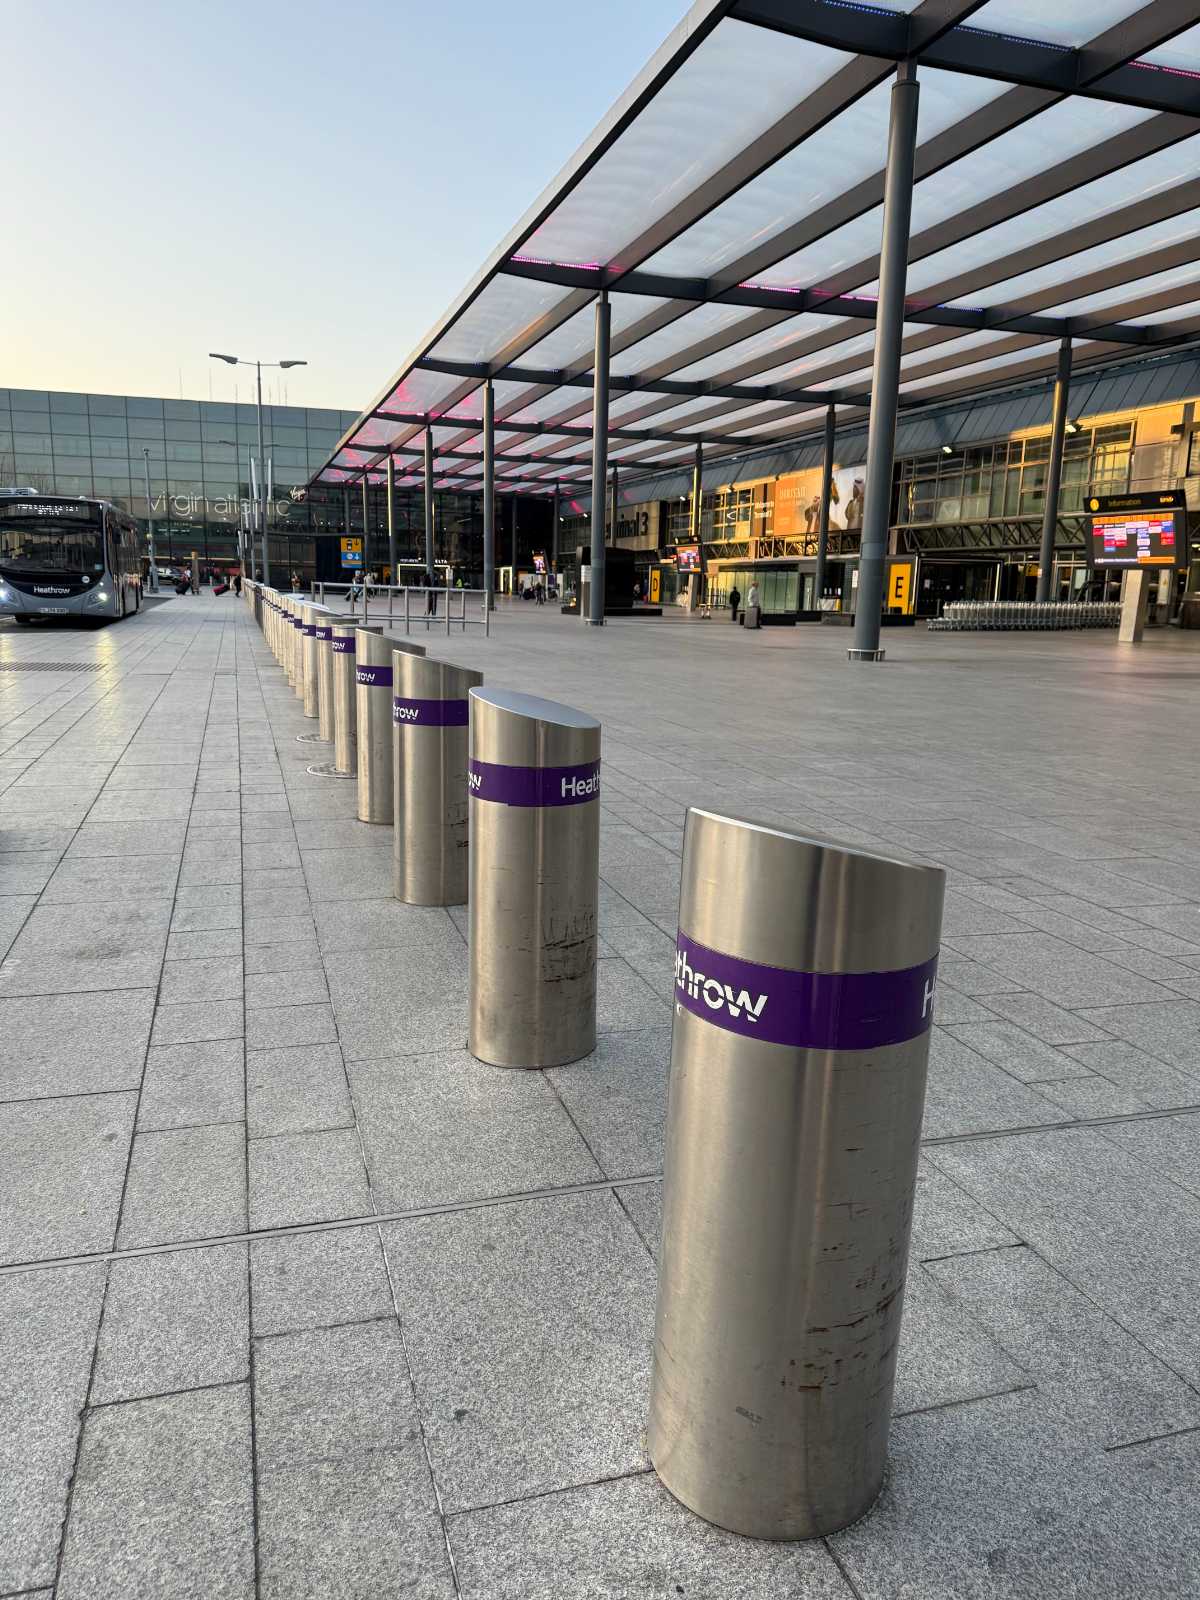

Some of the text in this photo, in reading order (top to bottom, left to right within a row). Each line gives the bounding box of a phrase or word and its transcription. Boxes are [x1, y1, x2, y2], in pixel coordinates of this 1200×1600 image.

[150, 489, 210, 517] virgin
[640, 511, 649, 536] 3
[33, 584, 71, 594] Heathrow
[652, 577, 659, 592] D
[895, 576, 904, 599] E
[675, 949, 769, 1023] throw
